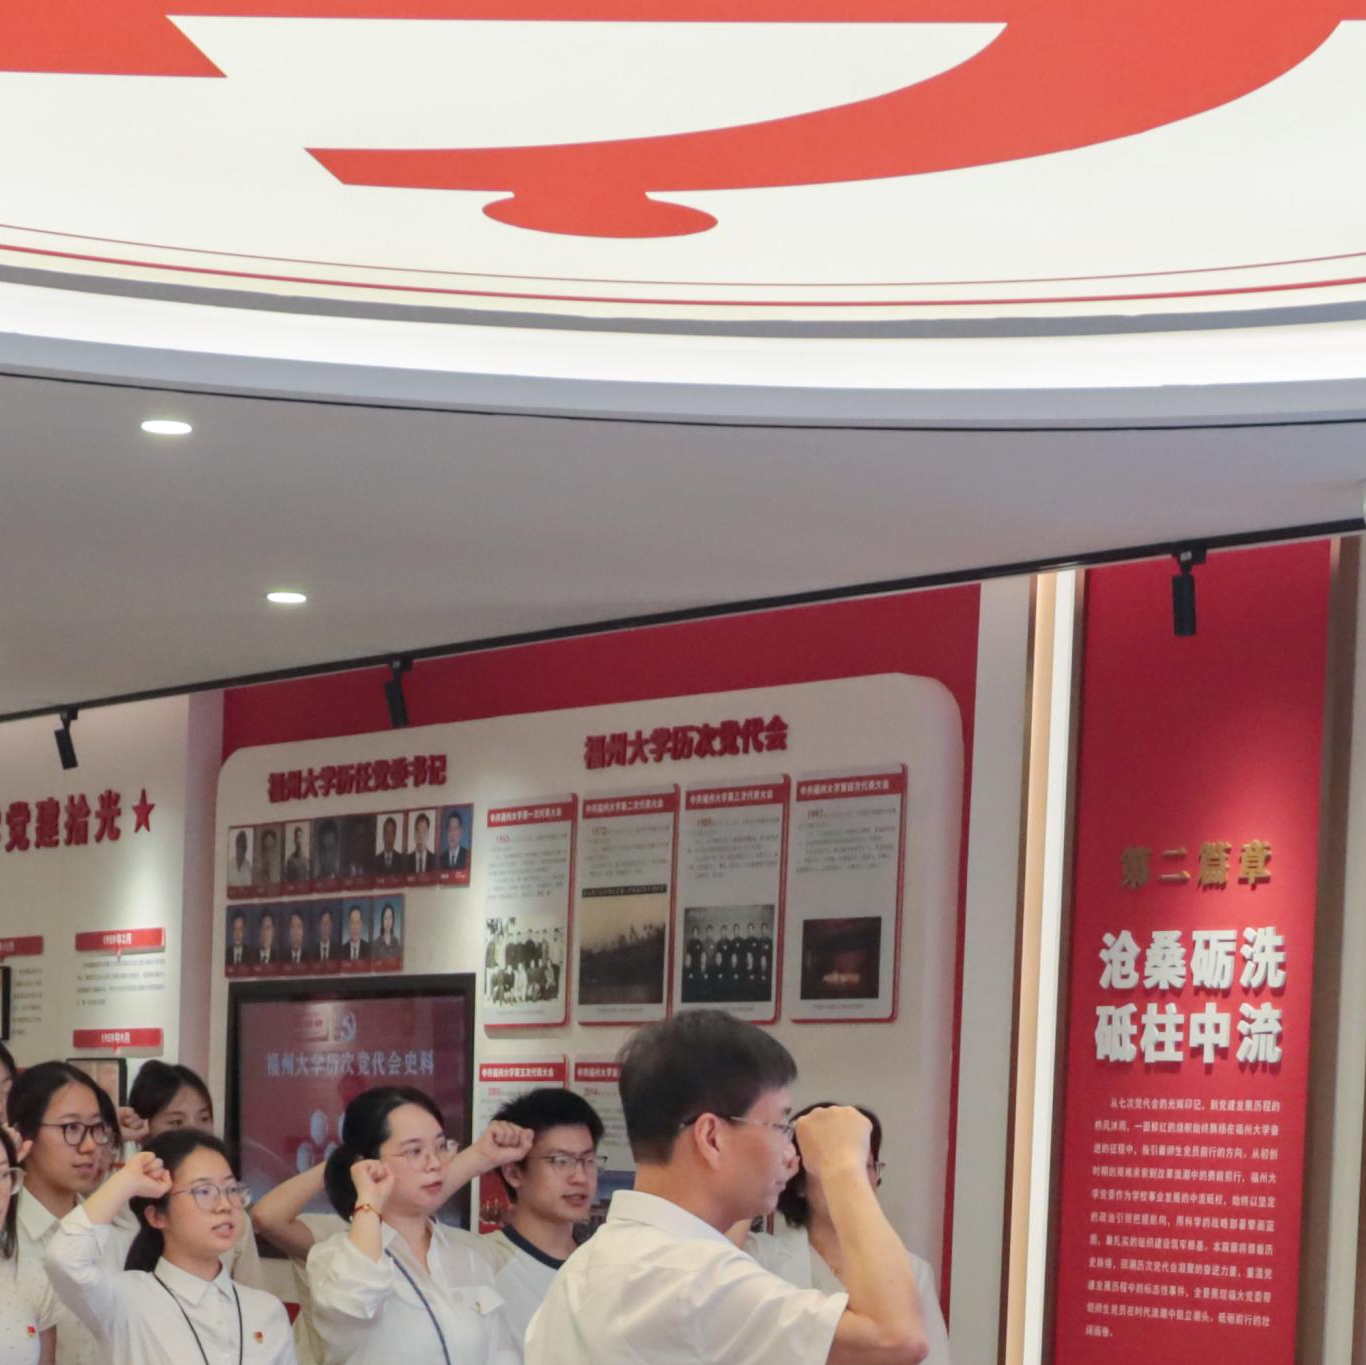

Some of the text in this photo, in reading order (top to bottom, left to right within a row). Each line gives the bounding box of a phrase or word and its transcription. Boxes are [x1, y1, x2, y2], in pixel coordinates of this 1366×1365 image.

[584, 714, 788, 770] 福州大学历次党代会
[267, 754, 447, 803] 福州大学历任党委书记
[1120, 839, 1272, 889] 第二篇章
[1099, 926, 1287, 990] 沧桑砺洗
[1094, 1002, 1283, 1064] 砥柱中流
[266, 1050, 435, 1077] 福州大学历次党代会史料
